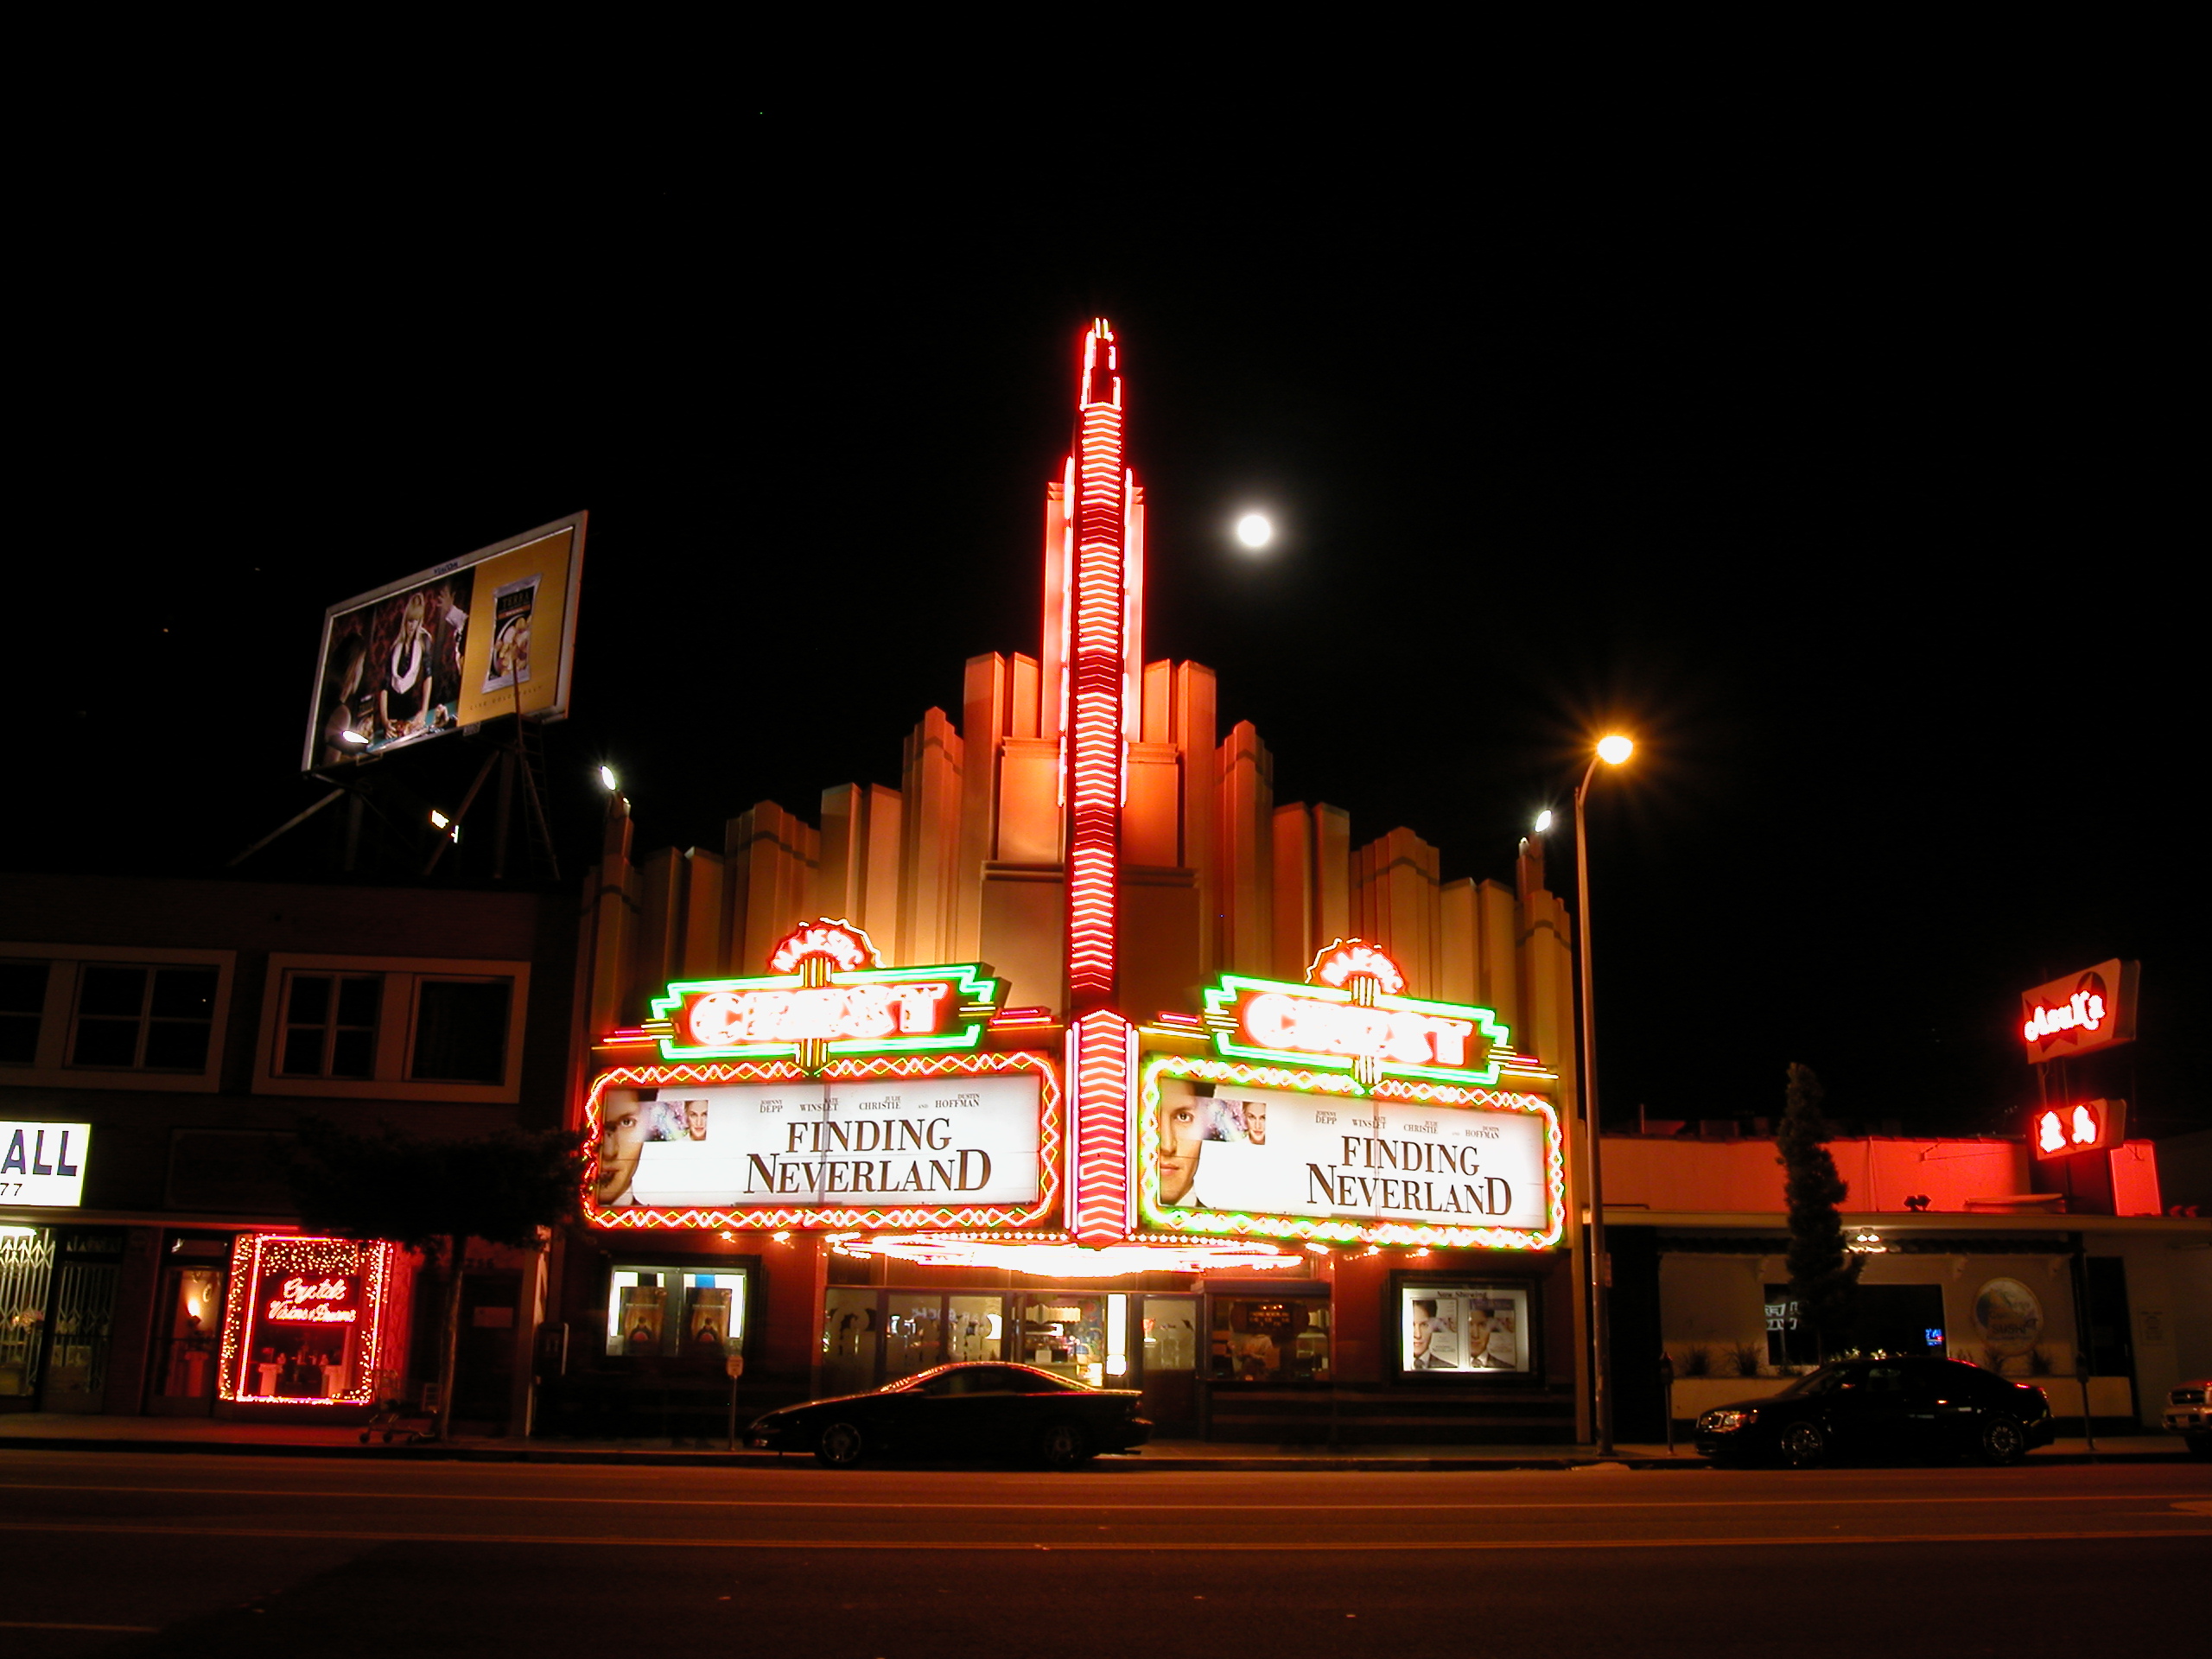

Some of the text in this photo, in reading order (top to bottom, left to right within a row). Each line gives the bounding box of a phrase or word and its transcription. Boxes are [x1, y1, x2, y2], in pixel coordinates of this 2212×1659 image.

[690, 982, 949, 1046] CREST
[760, 1104, 784, 1113] DEPP
[798, 1103, 840, 1113] WINSLET
[858, 1101, 902, 1110] CHRISTIE
[934, 1098, 981, 1109] HOFFMAN
[1315, 1115, 1338, 1126] DEPP
[1351, 1118, 1387, 1129] WINSLET
[1403, 1123, 1439, 1135] CHRISTIE
[1465, 1129, 1500, 1140] HOFFMAN
[0, 1128, 78, 1177] ALL
[785, 1117, 952, 1154] FINDING
[1341, 1135, 1480, 1176] FINDING
[743, 1149, 993, 1196] NEVERLAND
[1306, 1162, 1513, 1217] NEVERLAND
